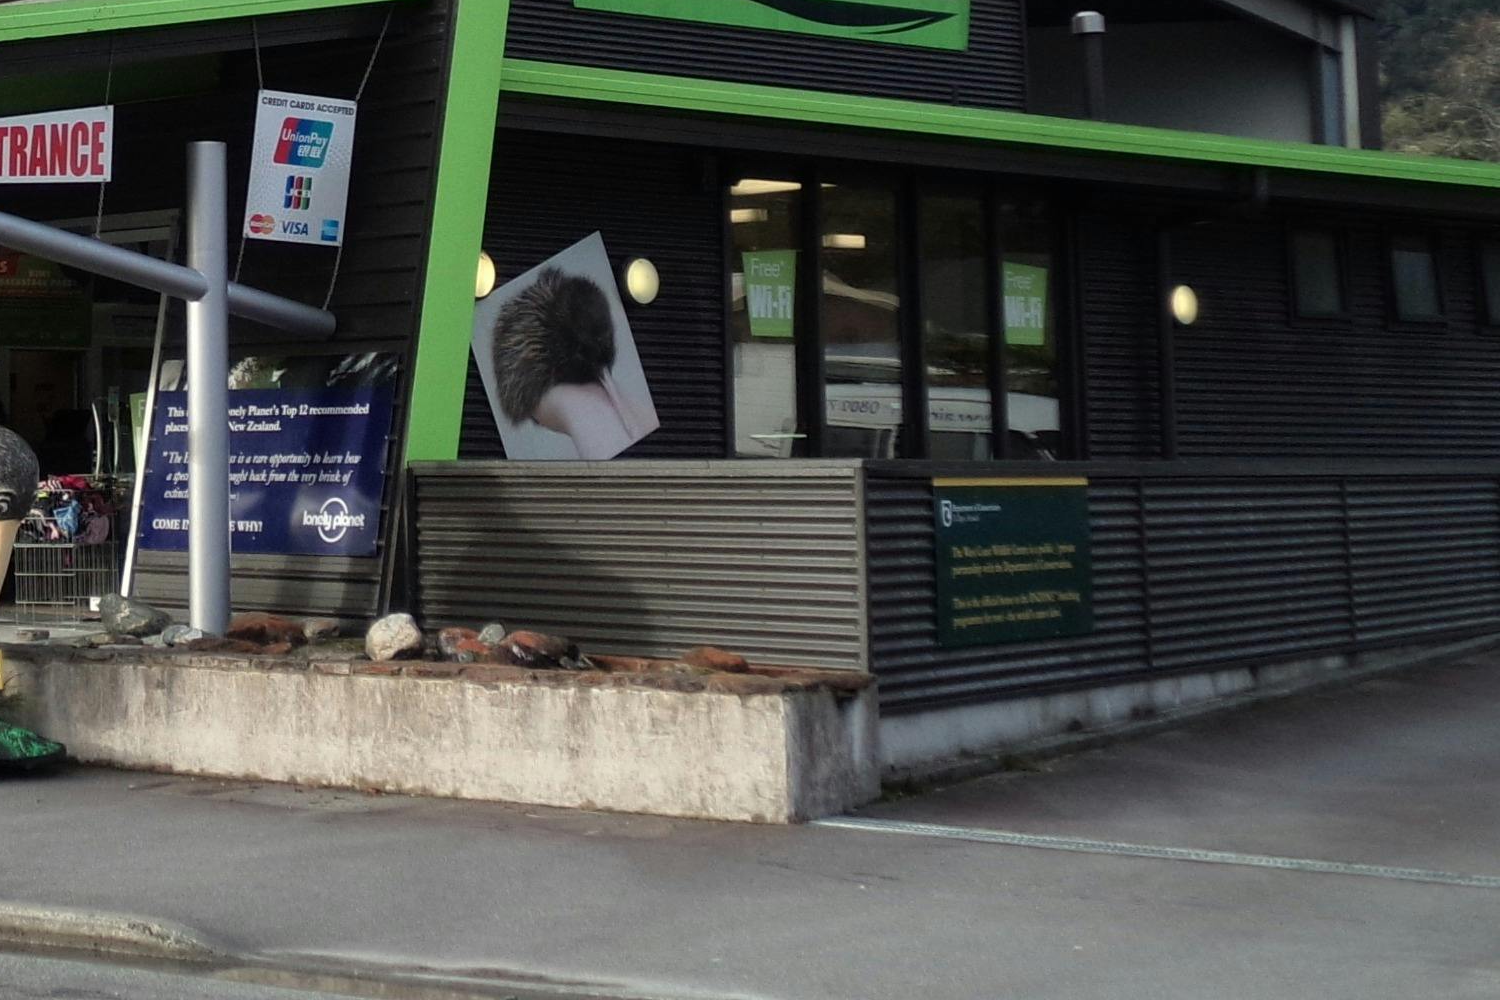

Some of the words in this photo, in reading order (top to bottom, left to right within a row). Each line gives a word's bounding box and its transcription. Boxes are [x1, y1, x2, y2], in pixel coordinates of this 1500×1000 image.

[262, 97, 288, 108] CREDIT
[290, 100, 315, 111] CARDS
[316, 104, 355, 116] ACCEPTED
[282, 128, 329, 150] UnionPay
[282, 221, 308, 236] VISA
[749, 284, 792, 319] Wi-Fi
[1004, 296, 1044, 329] Wi-Fi
[167, 406, 184, 418] This
[248, 404, 280, 416] Planet's
[281, 404, 297, 418] Top
[299, 404, 308, 415] 12
[309, 403, 370, 415] recommended
[246, 420, 282, 432] Zealand.
[238, 452, 246, 464] is
[252, 456, 268, 464] rare
[269, 452, 312, 468] opportunity
[313, 453, 321, 464] to
[322, 450, 344, 464] learn
[344, 450, 362, 464] how
[248, 468, 267, 482] back
[265, 469, 286, 486] from
[287, 469, 300, 482] the
[301, 474, 318, 486] very
[318, 469, 342, 482] brink
[342, 470, 354, 486] of
[152, 518, 180, 530] COME
[237, 520, 263, 532] WHY?
[302, 510, 332, 531] lonely
[332, 511, 365, 530] planet
